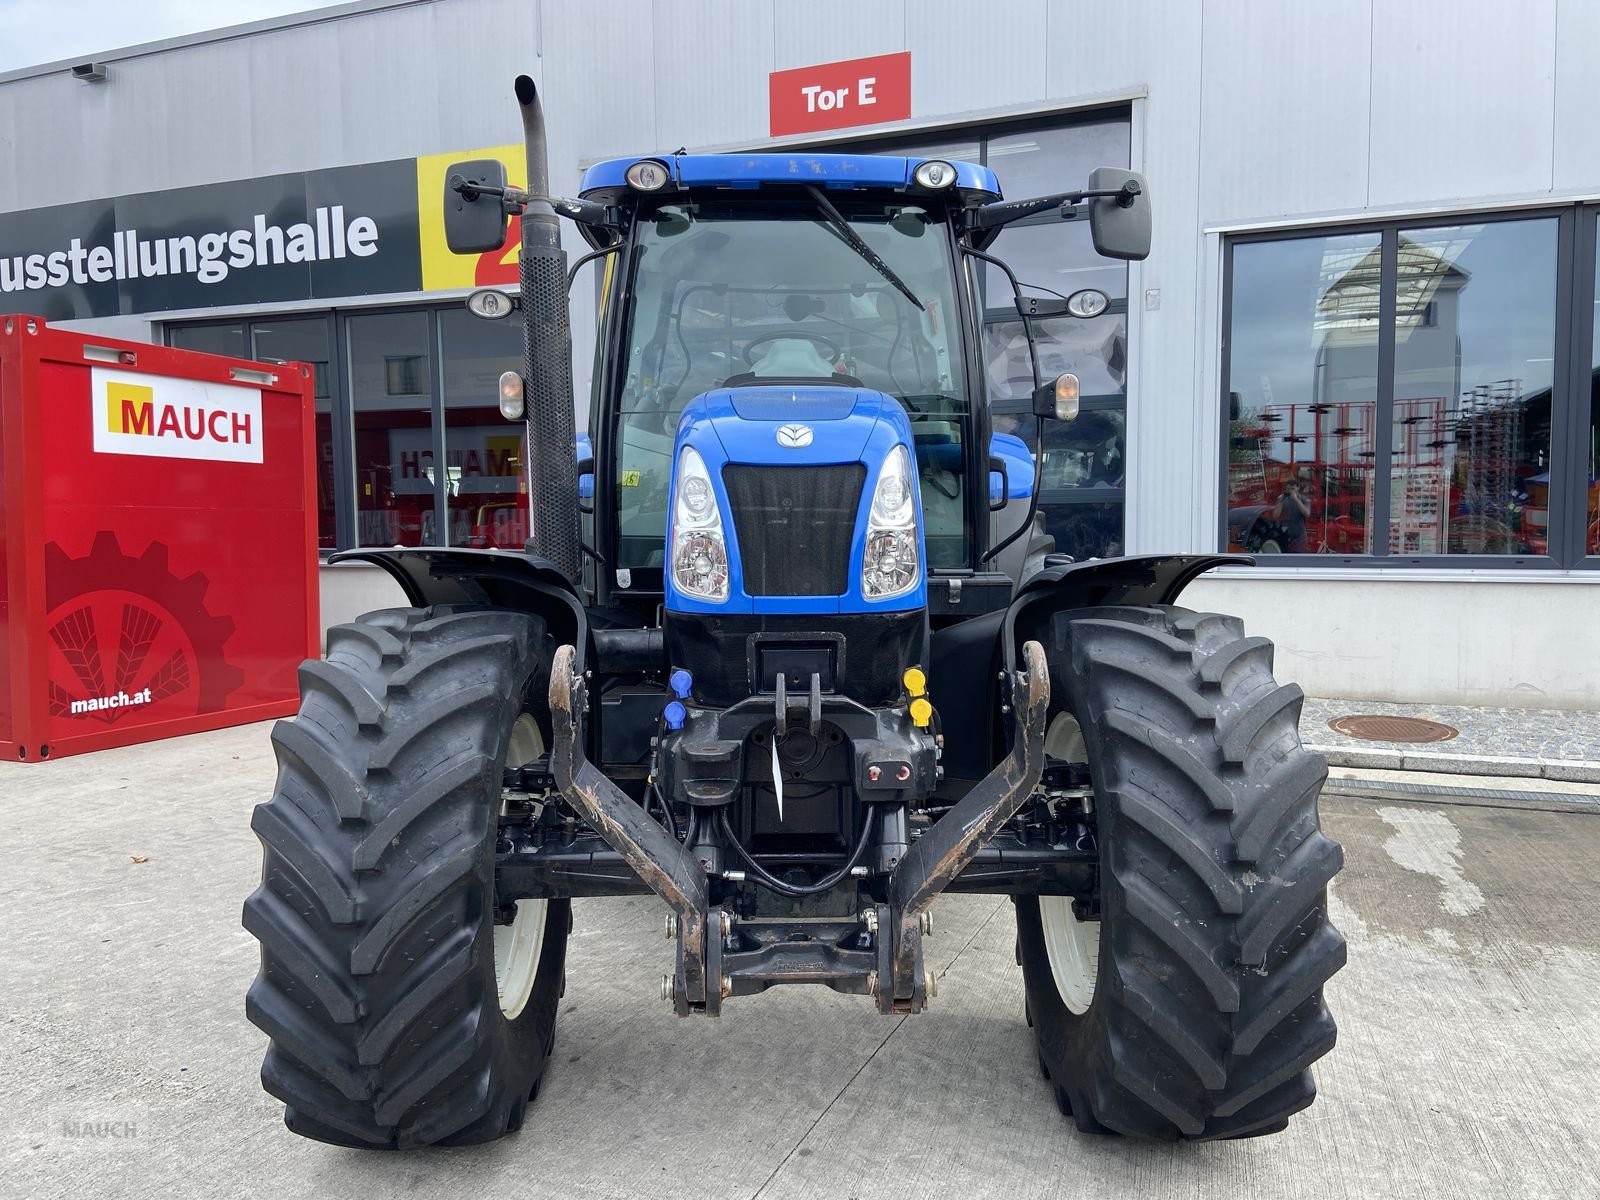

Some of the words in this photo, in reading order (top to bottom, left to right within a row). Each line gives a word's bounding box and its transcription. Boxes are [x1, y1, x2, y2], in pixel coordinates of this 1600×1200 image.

[801, 85, 849, 113] Tor
[858, 77, 877, 106] E
[0, 205, 378, 293] usstellungshalle
[121, 399, 252, 445] MAUCH
[71, 687, 151, 714] mauch.at
